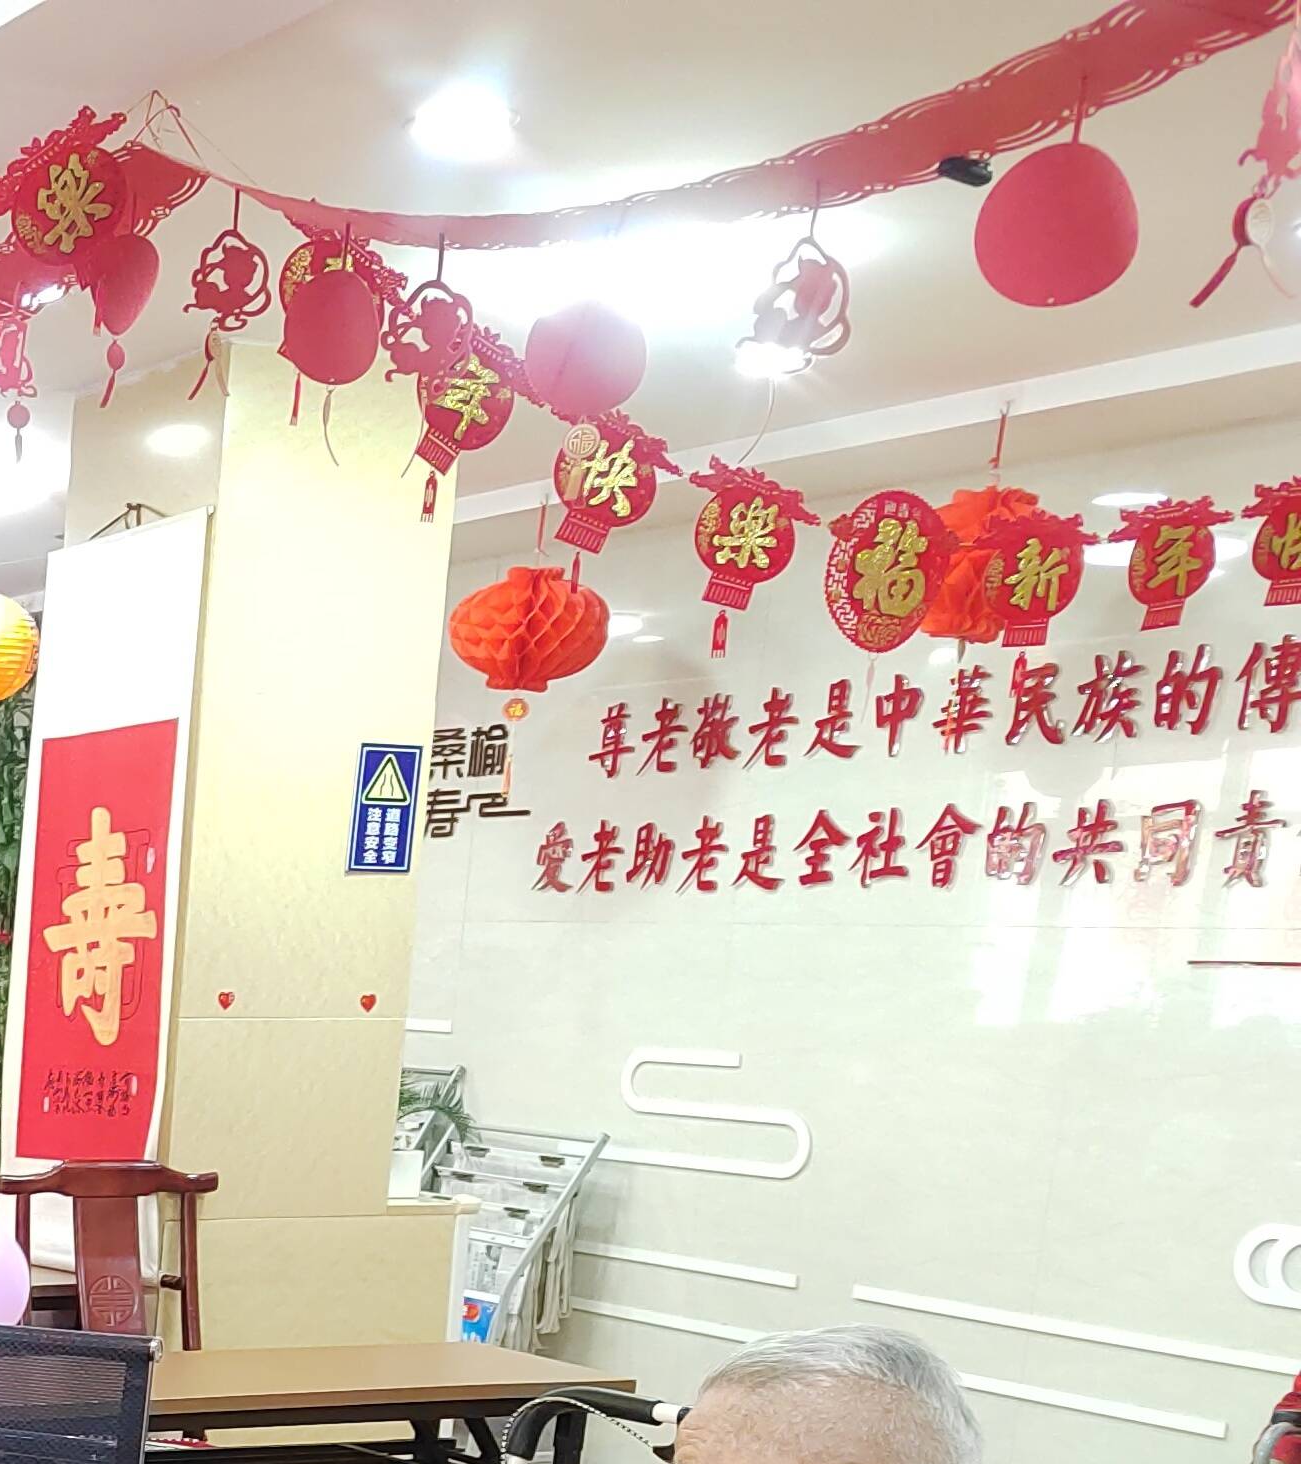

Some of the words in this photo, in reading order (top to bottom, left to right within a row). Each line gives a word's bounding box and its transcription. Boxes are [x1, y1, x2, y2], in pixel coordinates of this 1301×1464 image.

[431, 354, 500, 440] 年
[581, 439, 637, 517] 快
[853, 517, 928, 617] 福
[1004, 538, 1070, 611] 新
[1145, 525, 1204, 596] 年
[362, 807, 383, 865] 注意安全
